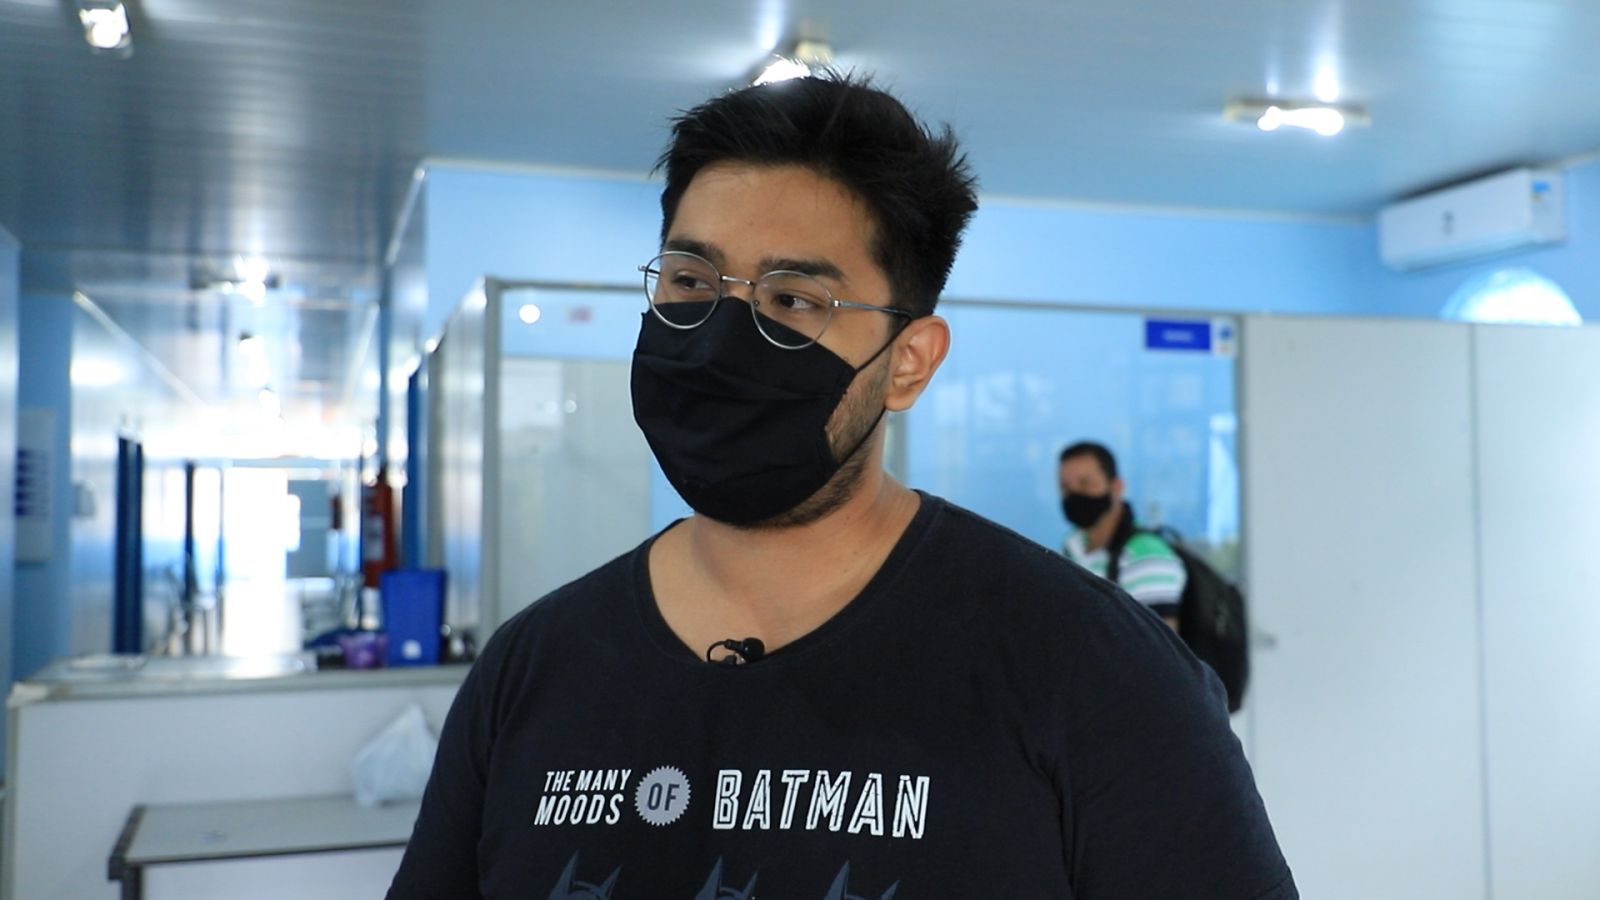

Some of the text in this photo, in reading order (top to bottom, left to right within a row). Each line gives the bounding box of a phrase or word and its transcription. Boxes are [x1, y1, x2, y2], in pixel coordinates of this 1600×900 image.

[544, 769, 632, 793] THE MANY
[533, 793, 624, 826] MOODS
[647, 782, 680, 812] OF
[712, 769, 930, 840] BATMAN
